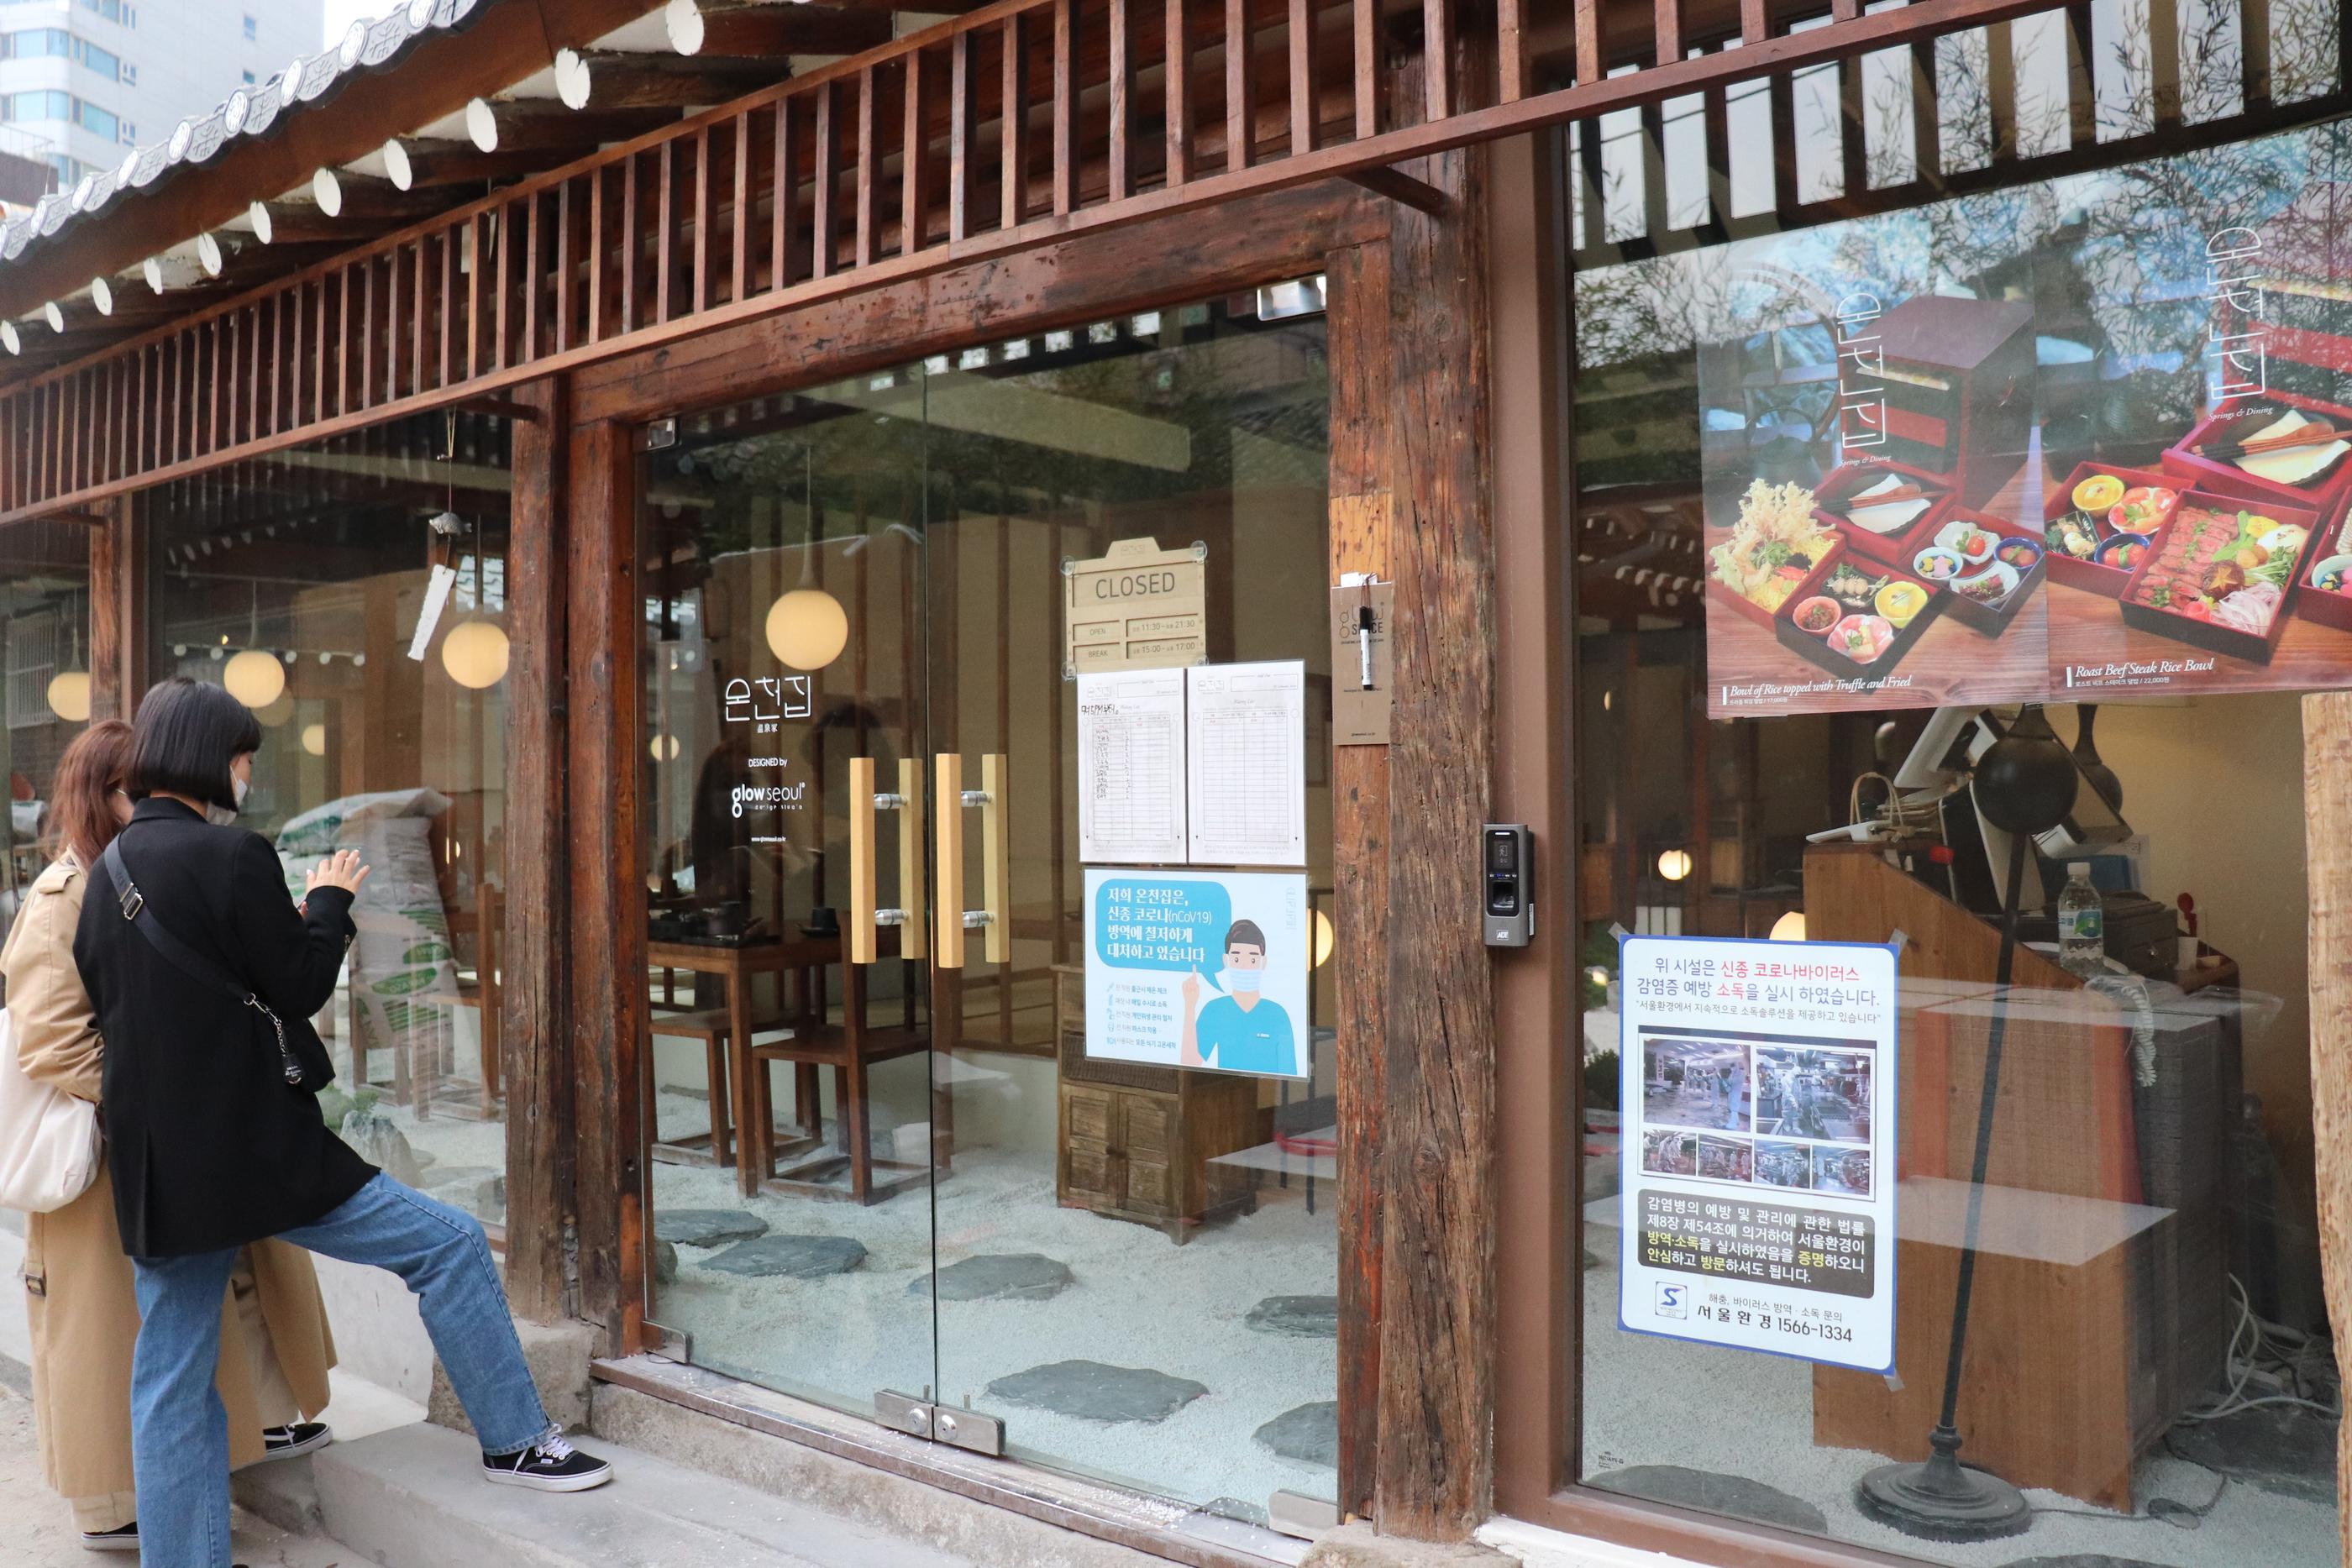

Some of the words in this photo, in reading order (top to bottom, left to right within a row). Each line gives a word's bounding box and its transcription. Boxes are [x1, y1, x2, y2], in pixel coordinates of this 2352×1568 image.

[2208, 411, 2234, 422] Springs
[2236, 408, 2244, 417] &
[2246, 406, 2274, 417] Dining
[1840, 456, 1861, 467] Springs
[1861, 455, 1869, 464] &
[1869, 454, 1892, 464] Dining
[1095, 572, 1175, 599] CLOSED
[1175, 619, 1195, 628] 21:30
[1339, 605, 1383, 638] glw
[1352, 622, 1383, 635] SCE
[1142, 645, 1161, 653] 15:00
[1175, 642, 1195, 651] 17:00
[2076, 666, 2103, 677] Roast
[2104, 663, 2130, 679] Beef
[2129, 661, 2157, 674] Steak
[2160, 661, 2181, 673] Rice
[2184, 658, 2214, 671] Bowl
[1730, 685, 1751, 697] Bowl
[1753, 685, 1763, 699] of
[1763, 684, 1782, 695] Rice
[1783, 680, 1812, 698] topped
[1813, 679, 1833, 691] with
[1835, 677, 1866, 695] Truffle
[1866, 677, 1885, 689] and
[1887, 674, 1913, 688] Fried
[726, 675, 811, 722] 온천집
[748, 758, 779, 768] DESIGNED
[779, 758, 788, 768] by
[1107, 887, 1131, 903] 저희
[1136, 889, 1189, 906] 온천집은,
[1107, 905, 1131, 922] 신종
[1135, 908, 1212, 926] 코로나(nCoV19)
[1107, 925, 1142, 941] 방역에
[1145, 926, 1193, 944] 철저하게
[1107, 943, 1154, 960] 대처하고
[1158, 946, 1205, 963] 있습니다
[1655, 957, 1669, 974] 위
[1674, 959, 1715, 977] 시설은
[1720, 961, 1749, 978] 신종
[1754, 962, 1860, 982] 코로나바이러스
[1637, 978, 1679, 996] 감염증
[1683, 980, 1712, 998] 예방
[1717, 983, 1760, 1001] 소독을
[1765, 984, 1794, 1002] 실시
[1799, 986, 1880, 1006] 하였습니다.
[1694, 1003, 1738, 1015] 지속적으로
[1740, 1006, 1795, 1020] 소독솔루션을
[1798, 1009, 1835, 1022] 제공하고
[1647, 1197, 1699, 1215] 감염병의
[1705, 1200, 1731, 1219] 예방
[1738, 1208, 1750, 1222] 및
[1756, 1210, 1797, 1228] 관리에
[1803, 1215, 1830, 1233] 관한
[1838, 1219, 1866, 1236] 법률
[1647, 1214, 1679, 1230] 제8장
[1683, 1218, 1737, 1237] 제54조에
[1742, 1226, 1793, 1245] 의거하여
[1798, 1233, 1865, 1255] 서울환경이
[1647, 1248, 1696, 1266] 안심하고
[1700, 1255, 1764, 1277] 방문하셔도
[1769, 1265, 1811, 1283] 됩니다.
[1716, 1240, 1793, 1263] 실시하였음을
[1798, 1251, 1864, 1273] 증명하오니
[1709, 1293, 1730, 1305] 해충,
[1733, 1297, 1770, 1311] 바이러스
[1773, 1303, 1793, 1315] 방역
[1801, 1306, 1820, 1319] 소독
[1824, 1310, 1843, 1323] 문의
[1777, 1317, 1852, 1343] 1566-1334
